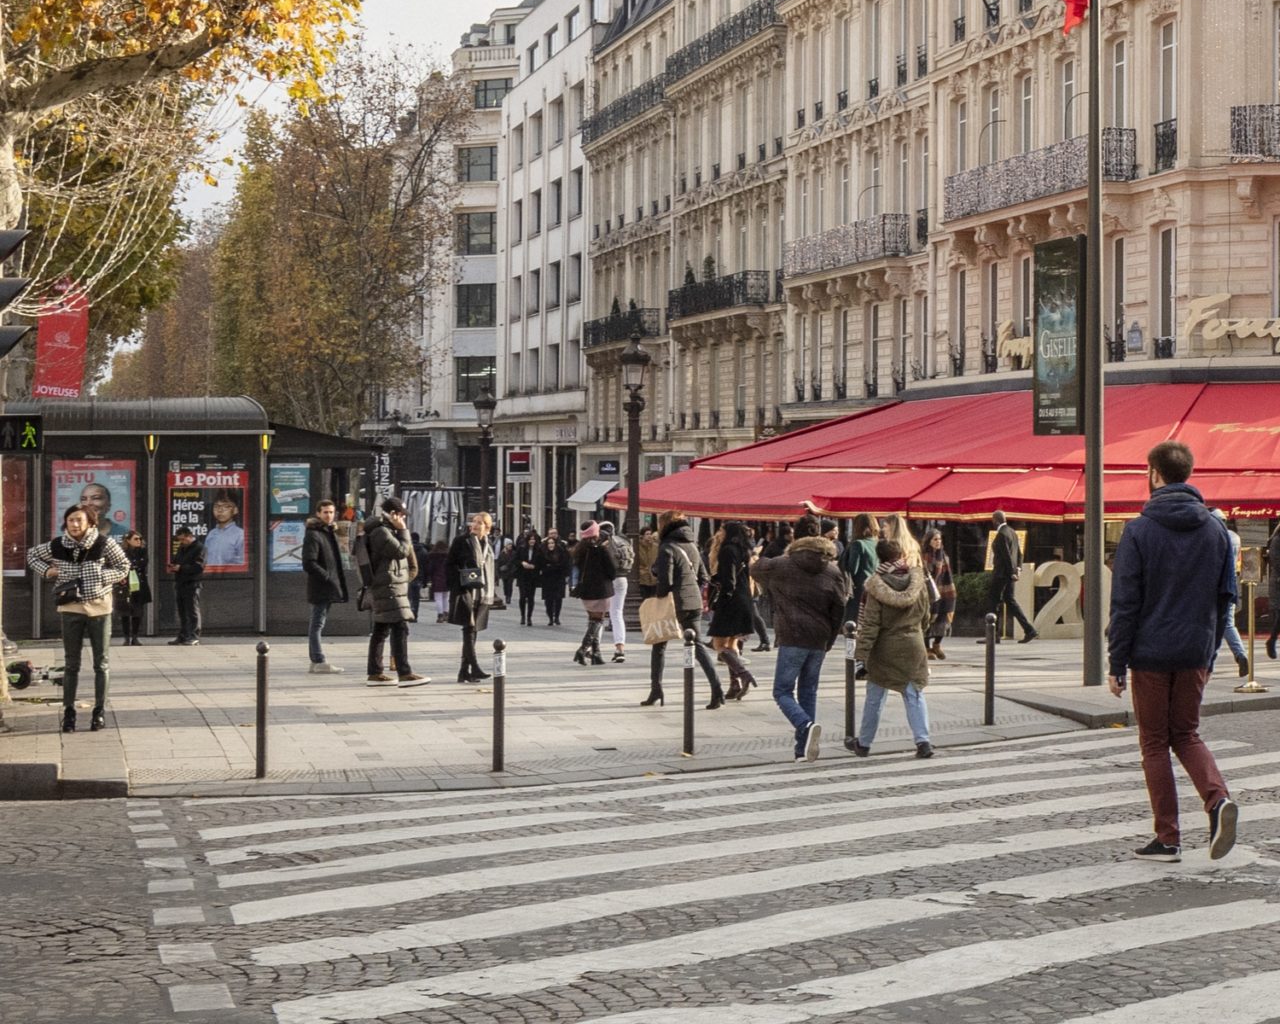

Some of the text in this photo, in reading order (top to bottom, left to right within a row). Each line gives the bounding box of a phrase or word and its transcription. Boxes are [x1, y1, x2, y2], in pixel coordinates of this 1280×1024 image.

[35, 385, 79, 397] JOYEUSES
[174, 472, 240, 486] Le Point
[173, 499, 205, 511] Héros
[173, 512, 199, 523] de la
[1231, 506, 1273, 517] Fouquet's
